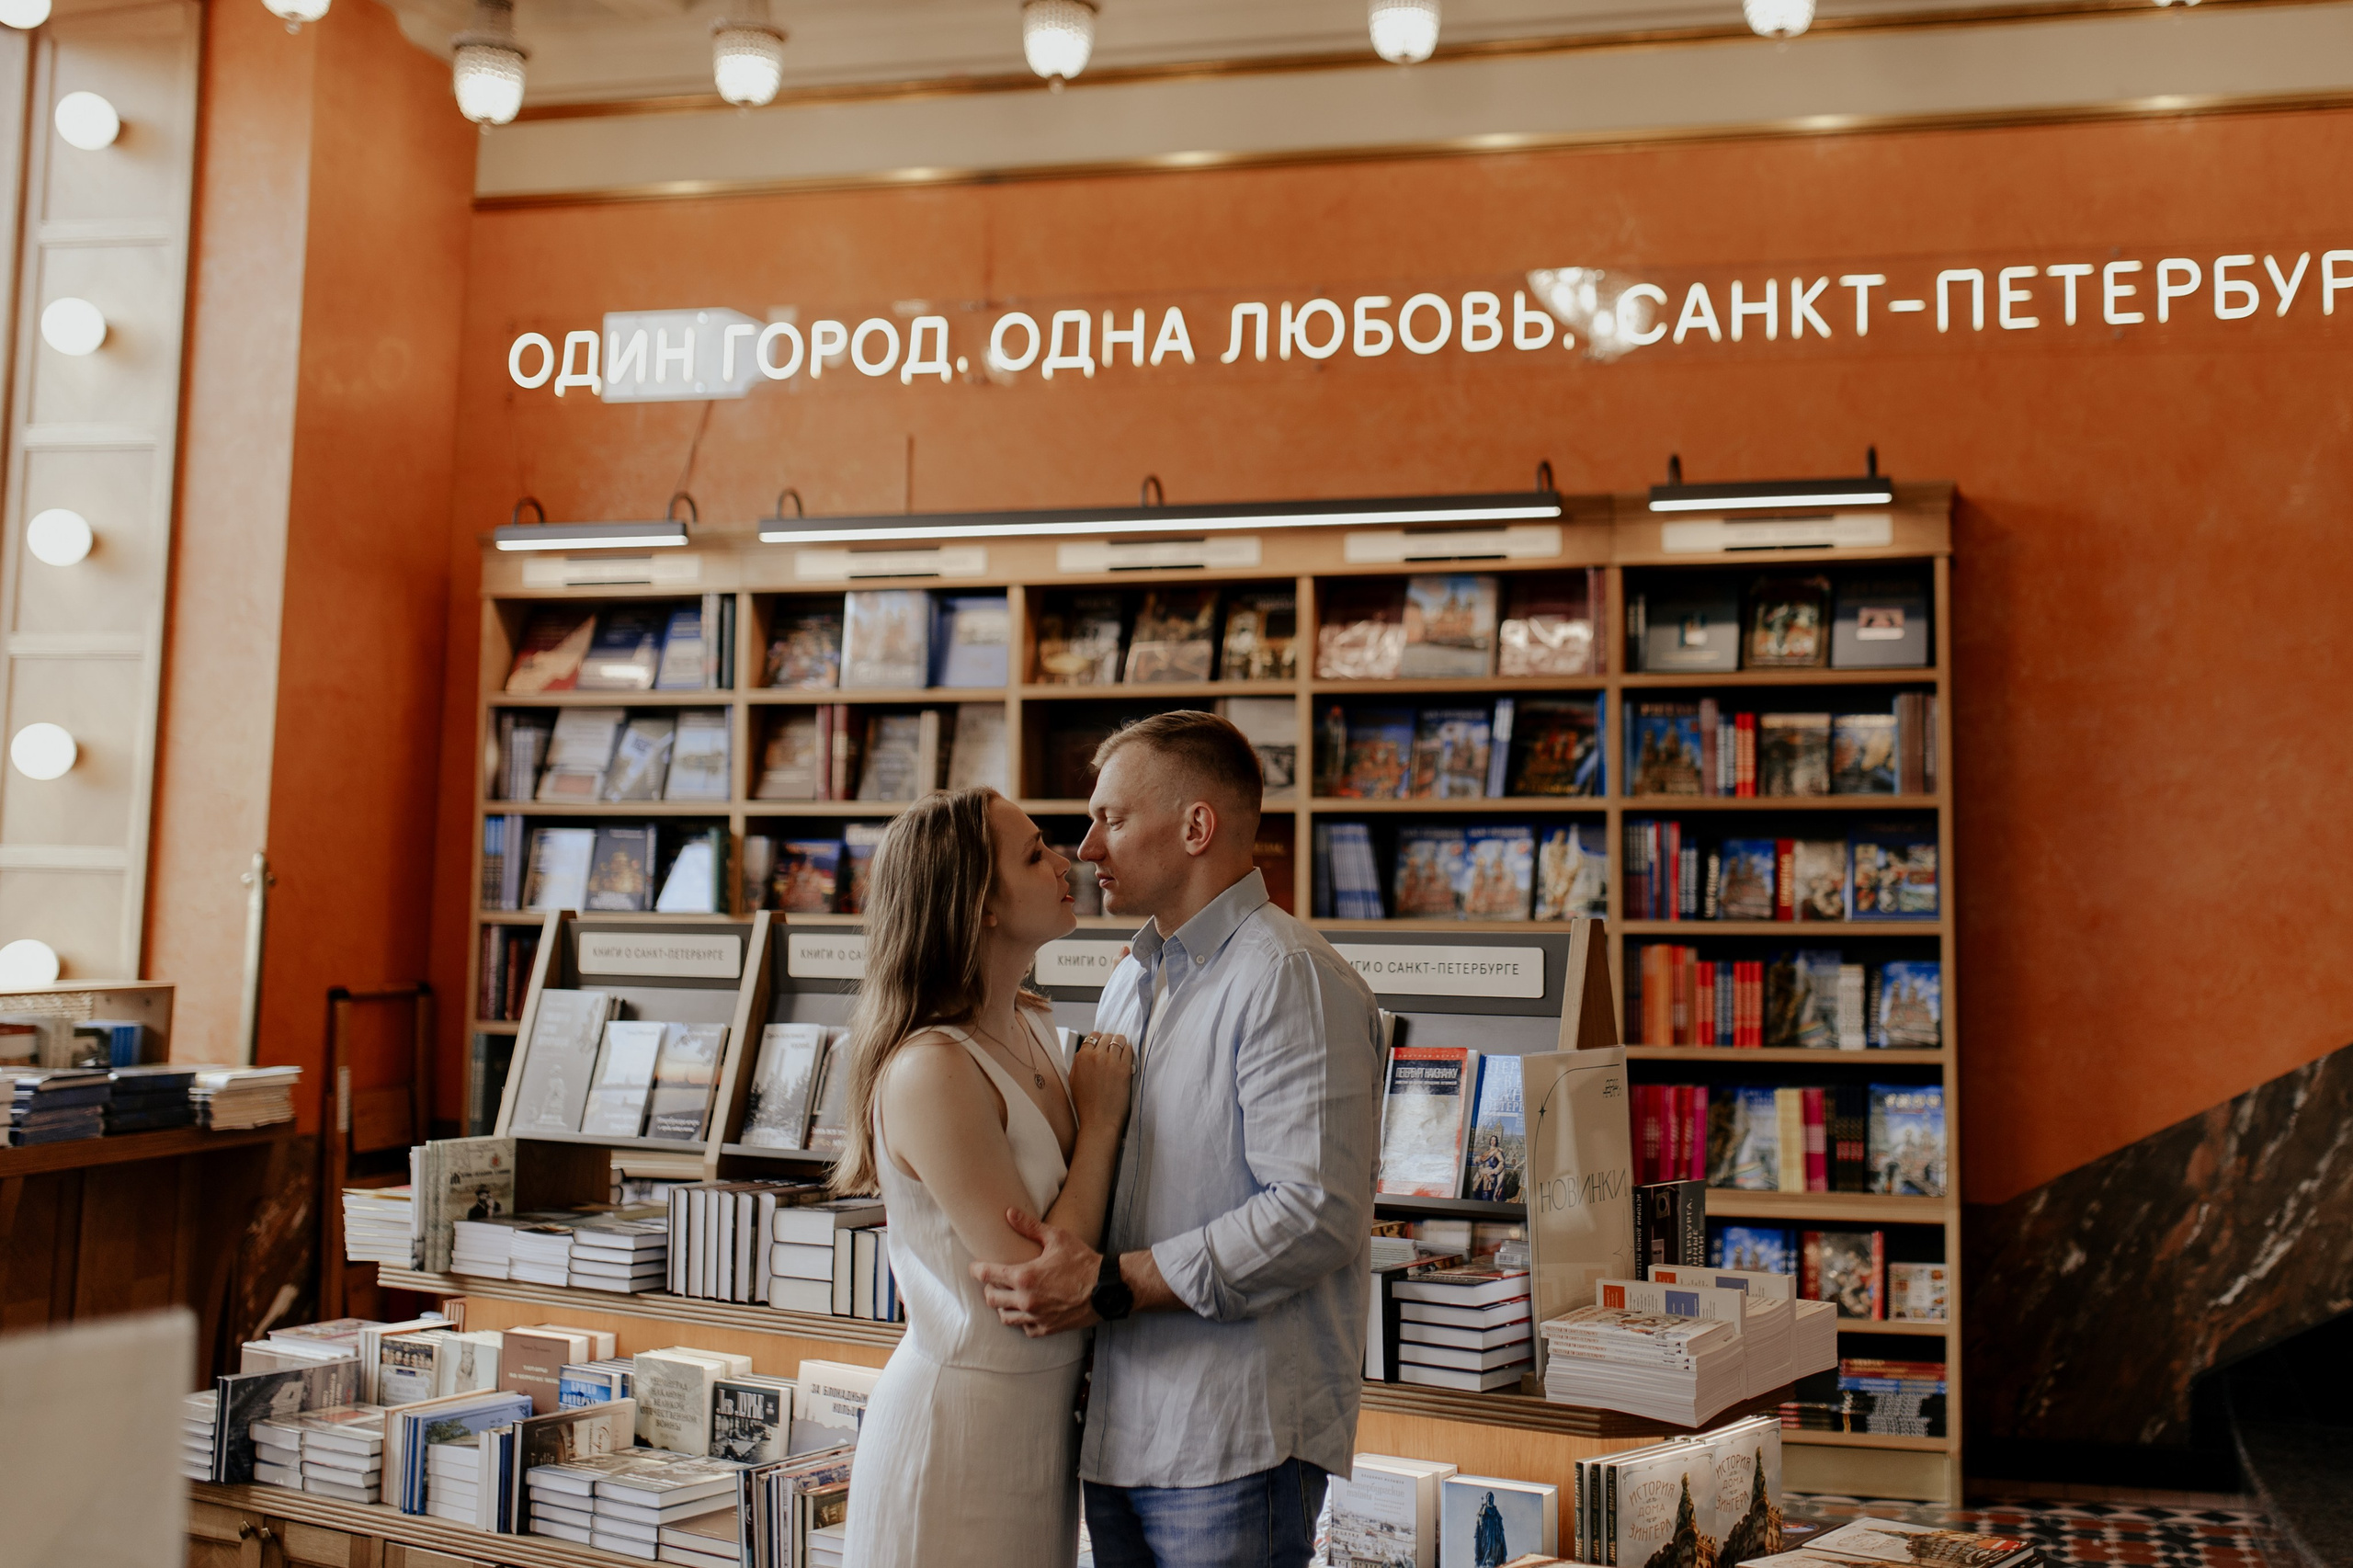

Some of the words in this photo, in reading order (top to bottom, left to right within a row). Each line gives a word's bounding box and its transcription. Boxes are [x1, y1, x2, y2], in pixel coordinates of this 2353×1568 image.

[508, 325, 697, 398] ОДИН
[722, 315, 970, 386] ГОРОД.
[990, 306, 1196, 381] ОДНА
[1220, 290, 1575, 365] ЛЮБОВЬ.
[593, 946, 621, 958] КНИГИ
[625, 947, 631, 959] О
[634, 947, 724, 960] САНКТ-ПЕТЕРБУРГЕ
[801, 948, 833, 960] КНИГИ
[837, 949, 846, 960] О
[848, 949, 865, 960] СА
[1057, 955, 1094, 966] КНИГИ
[1098, 956, 1107, 967] О
[1373, 961, 1383, 972] О
[1387, 961, 1519, 975] САНКТ-ПЕТЕРБУРГЕ
[1540, 1168, 1627, 1213] НОВИНКИ
[1716, 1454, 1751, 1480] ИСТОРИЯ
[1629, 1480, 1676, 1506] ИСТОРИЯ
[1722, 1476, 1745, 1491] ДОМА
[1637, 1503, 1665, 1518] ДОМА
[1715, 1490, 1749, 1513] ЗИНГЕРА
[1628, 1518, 1673, 1542] ЗИНГЕРА
